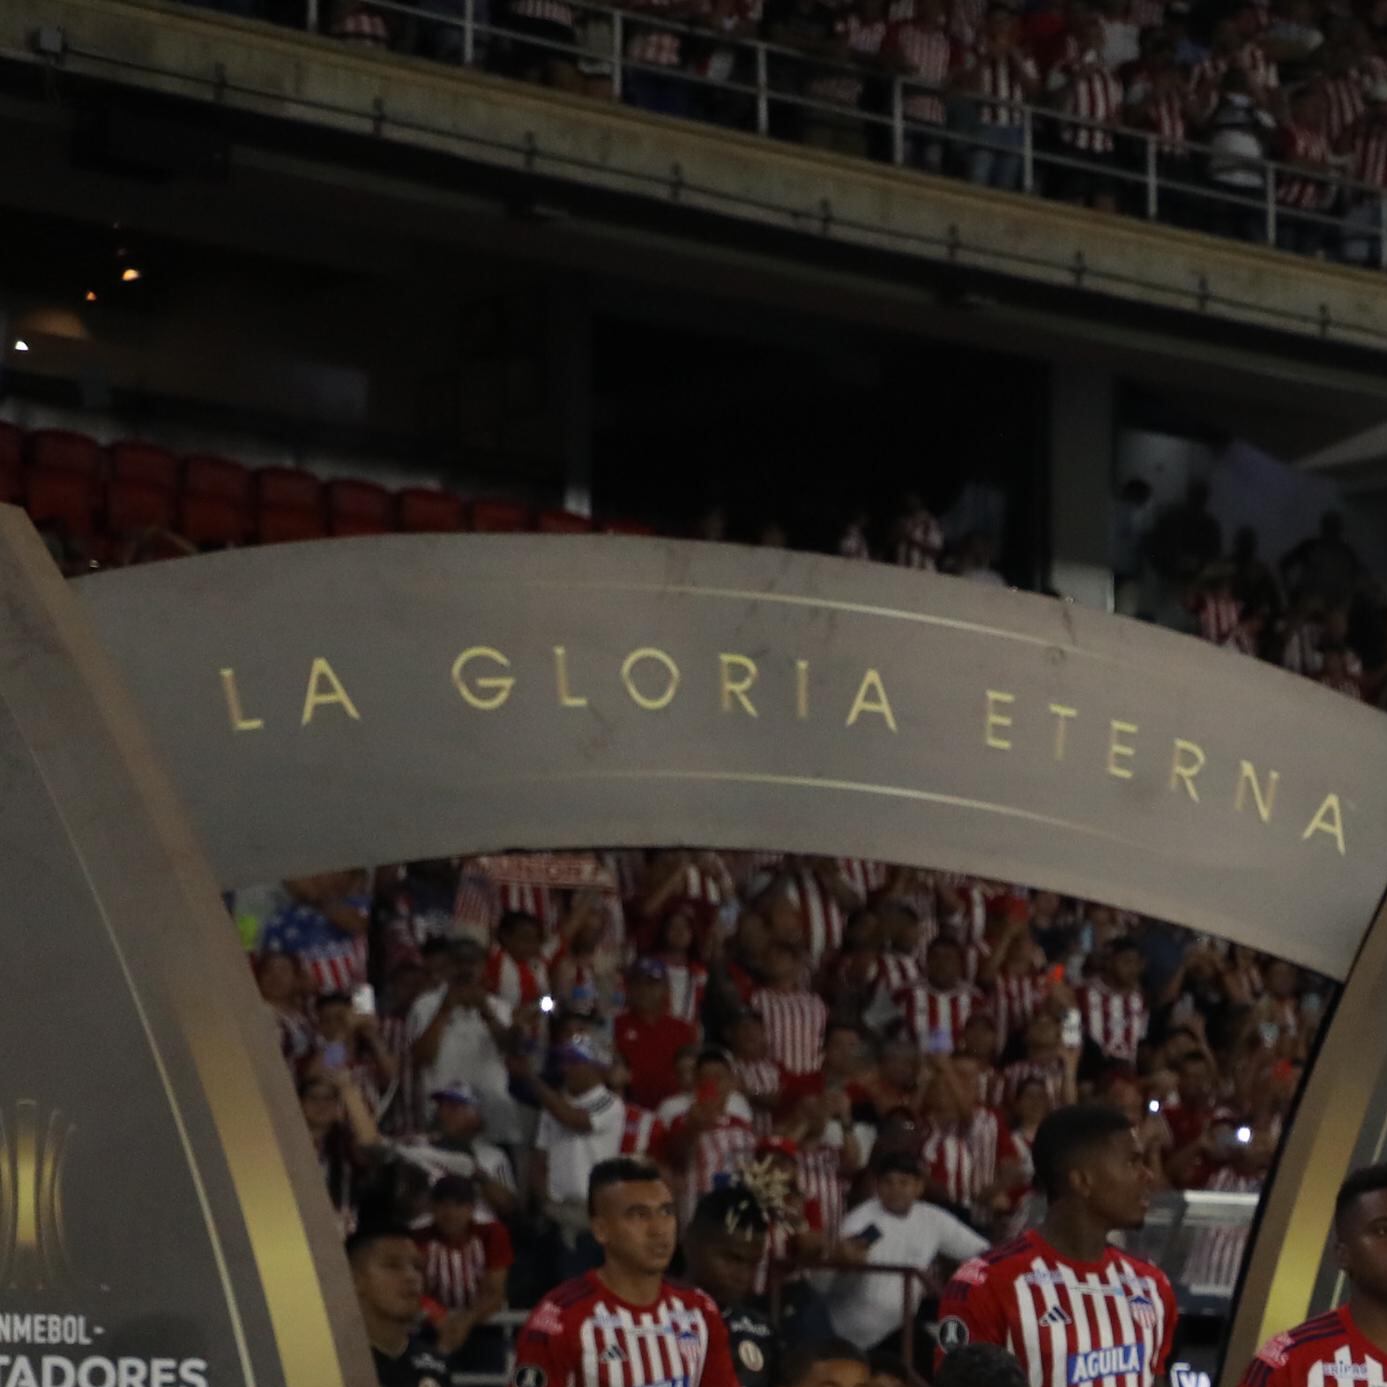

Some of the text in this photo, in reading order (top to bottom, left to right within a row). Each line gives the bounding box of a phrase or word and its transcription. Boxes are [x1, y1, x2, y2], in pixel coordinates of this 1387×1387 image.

[219, 643, 1346, 856] LA GLORIA ETERNA
[1071, 1346, 1141, 1384] AGUILA
